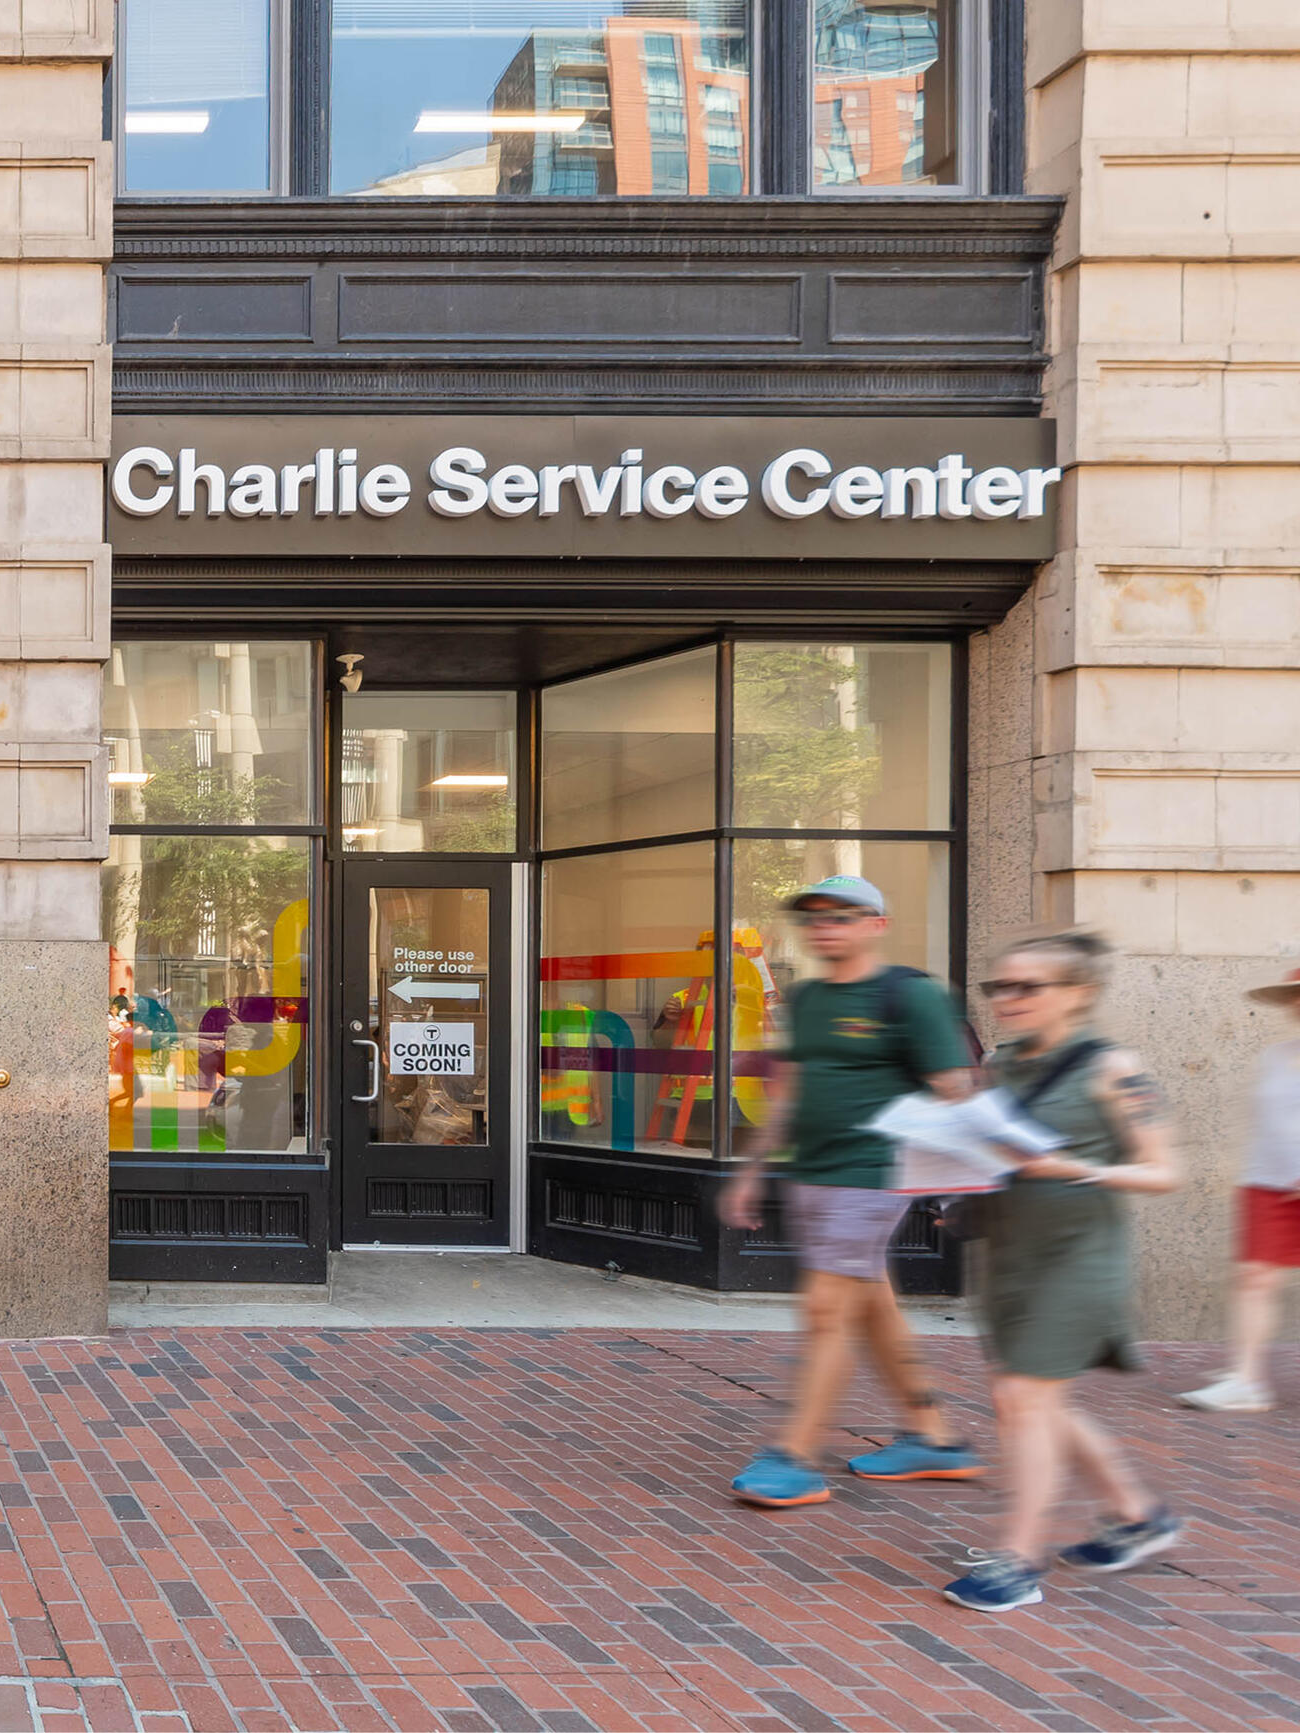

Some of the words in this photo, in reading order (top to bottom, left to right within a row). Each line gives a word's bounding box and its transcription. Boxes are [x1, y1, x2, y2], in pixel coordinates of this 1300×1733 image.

[112, 446, 411, 517] Charlie
[428, 446, 749, 519] Service
[762, 447, 1061, 519] Center
[393, 947, 443, 960] Please
[448, 950, 475, 960] use
[394, 961, 434, 973] other
[438, 961, 474, 974] door
[393, 1043, 471, 1057] COMING
[402, 1058, 461, 1072] SOON!
